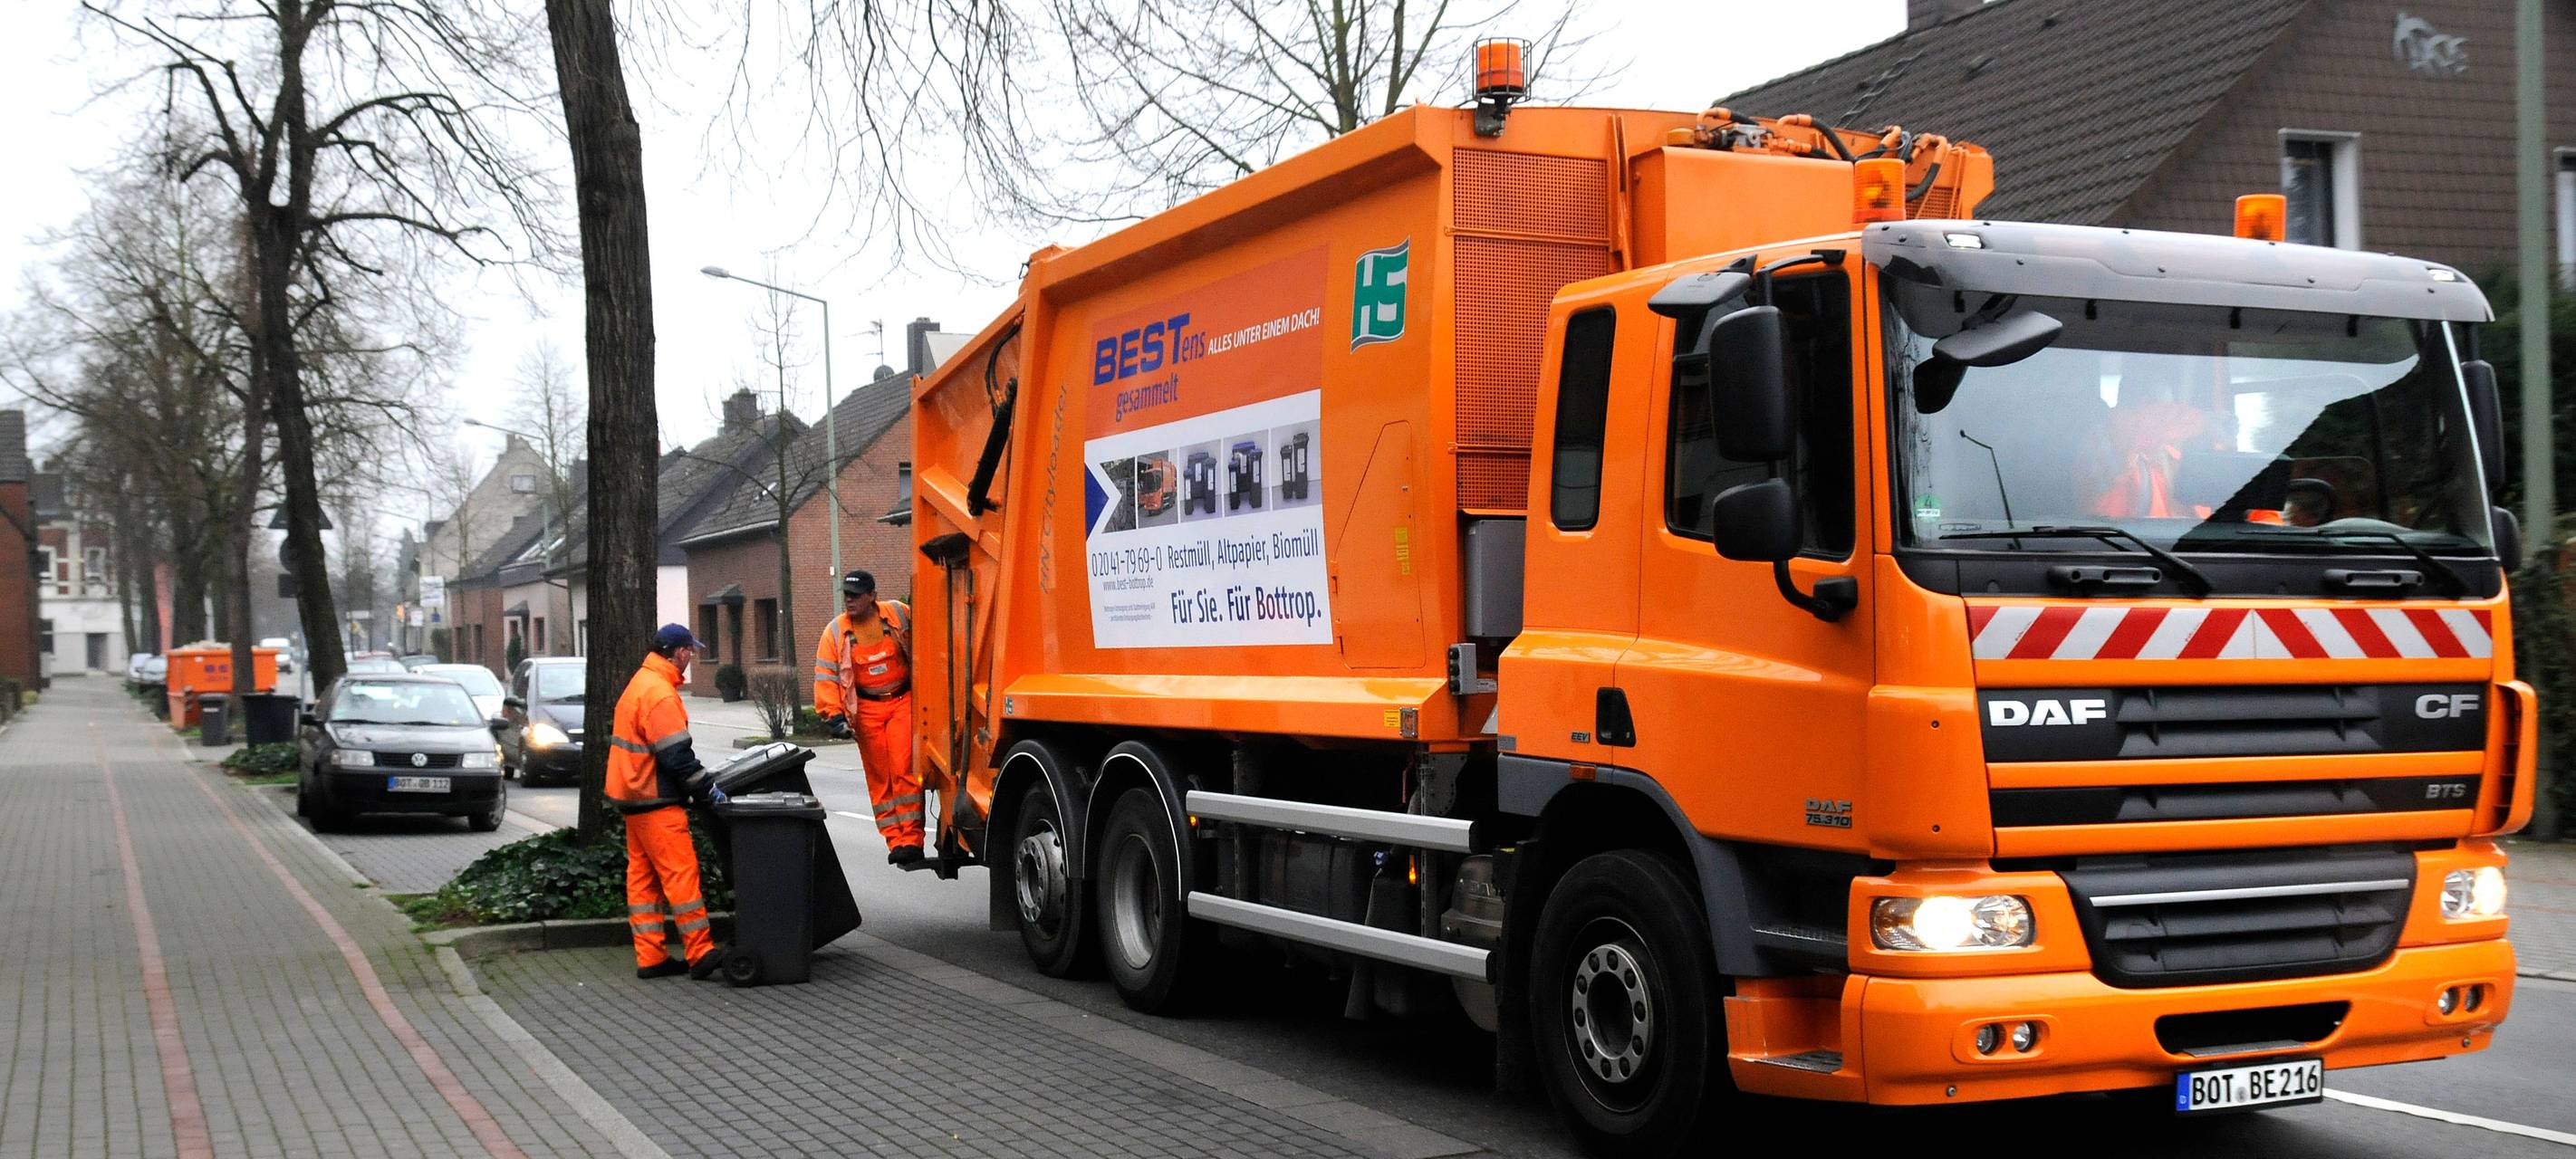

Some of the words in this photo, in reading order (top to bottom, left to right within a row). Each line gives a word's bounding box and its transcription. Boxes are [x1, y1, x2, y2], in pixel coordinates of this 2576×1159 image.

[1207, 337, 1232, 355] ALLES
[1233, 325, 1261, 348] UNTER
[1262, 316, 1290, 340] EINEM
[1291, 307, 1321, 333] DACH!
[1116, 372, 1179, 422] gesammelt
[1168, 540, 1215, 570] Restmüll,
[1217, 534, 1270, 570] Altpapier,
[1273, 528, 1319, 560] Biomüll
[1171, 589, 1193, 624] Für
[1197, 588, 1223, 623] Sie.
[1226, 585, 1251, 621] Für
[1255, 587, 1322, 627] Bottrop.
[1988, 699, 2107, 726] DAF
[2415, 694, 2480, 719] CF
[1572, 733, 1588, 742] EEV
[1806, 797, 1852, 813] DAF
[2427, 783, 2466, 799] BTS
[2192, 1075, 2234, 1105] BOT
